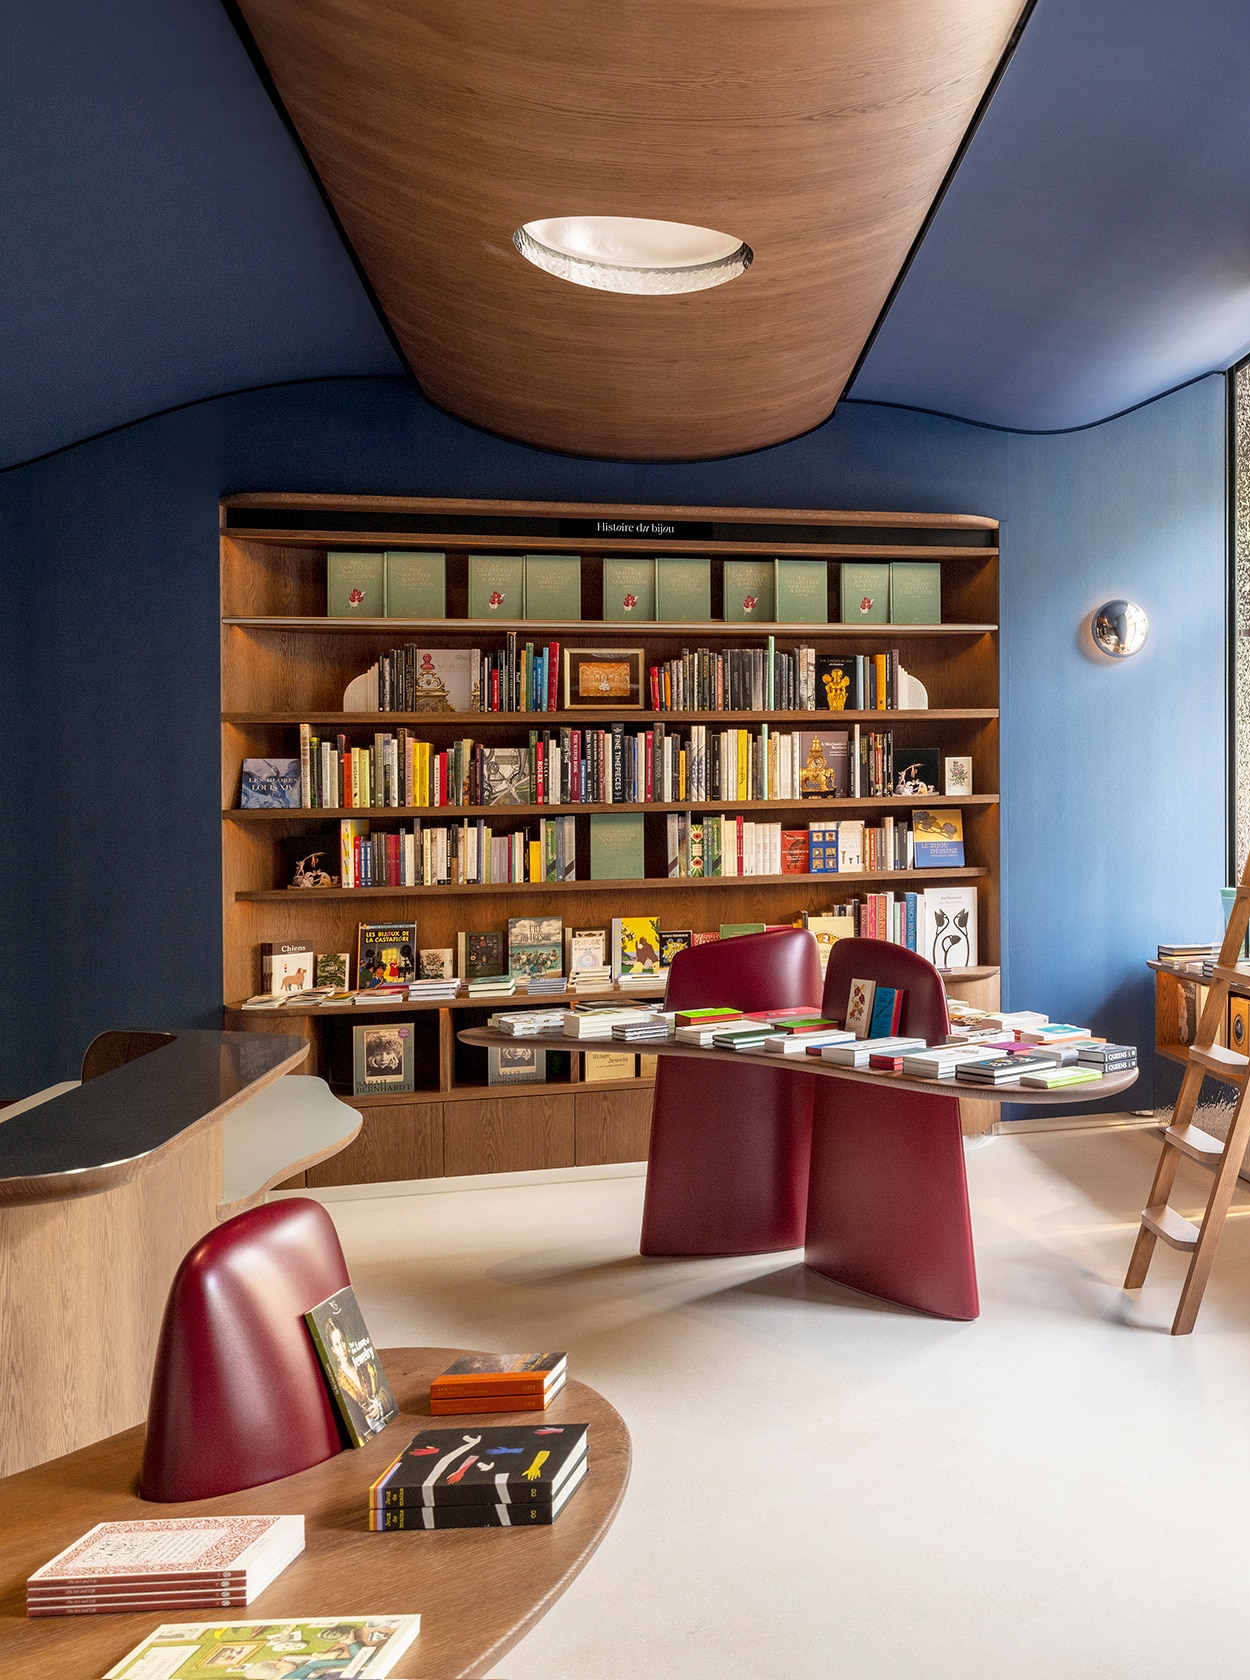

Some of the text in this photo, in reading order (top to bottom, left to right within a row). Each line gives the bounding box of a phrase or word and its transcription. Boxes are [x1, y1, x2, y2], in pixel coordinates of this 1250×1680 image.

[598, 522, 674, 536] Histoire du bijou
[1108, 1051, 1127, 1059] QUEENS
[356, 1084, 410, 1093] BERNHARDT
[352, 1346, 374, 1371] Jewelry
[530, 1489, 536, 1497] 8
[530, 1510, 536, 1518] 8
